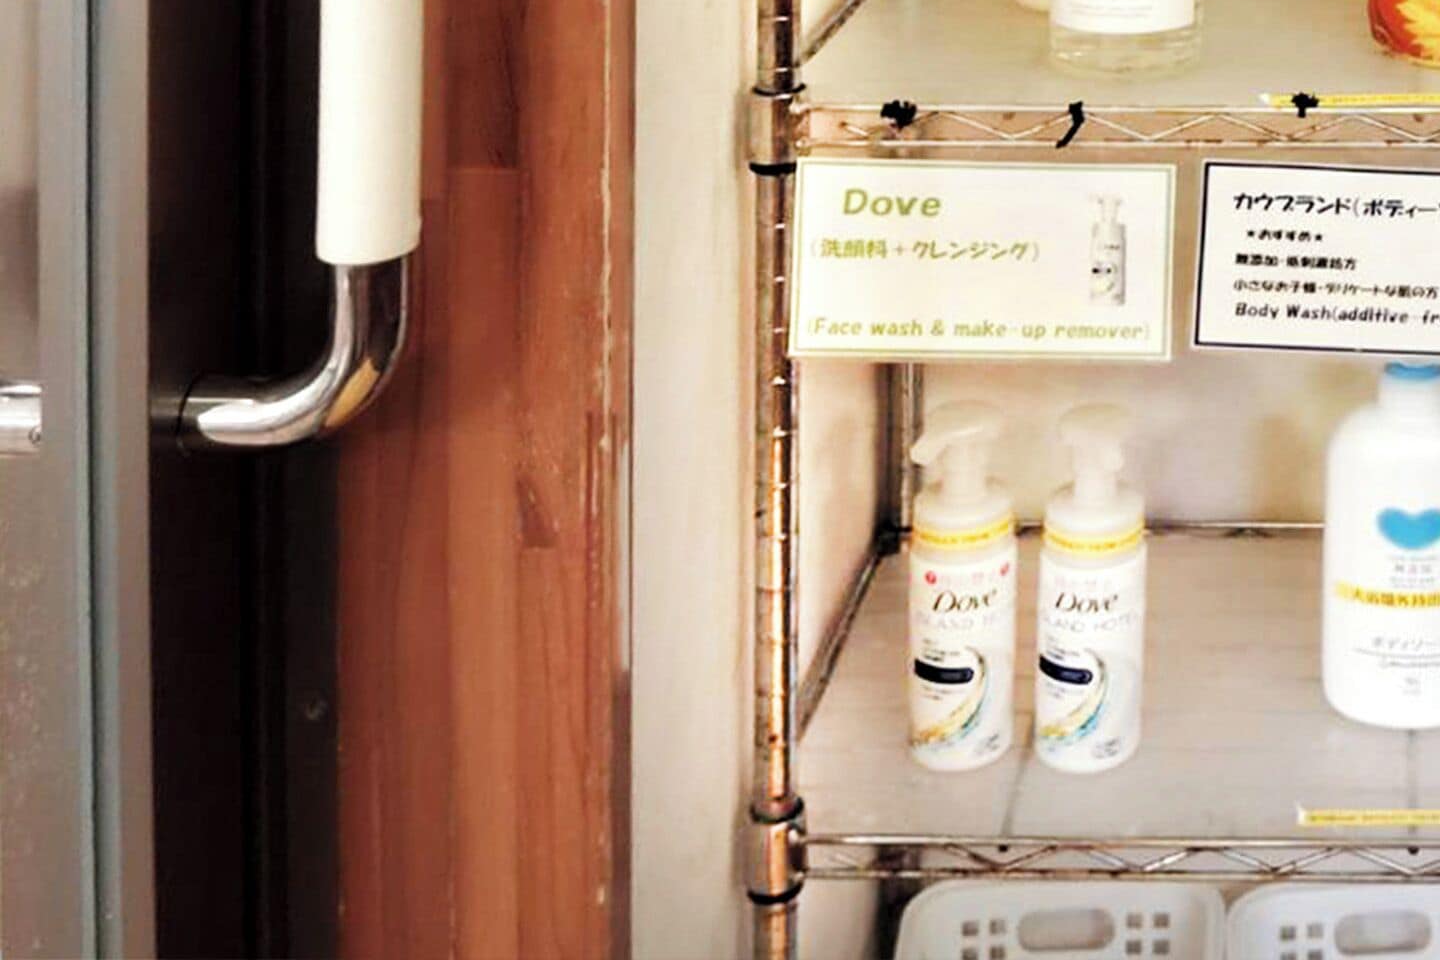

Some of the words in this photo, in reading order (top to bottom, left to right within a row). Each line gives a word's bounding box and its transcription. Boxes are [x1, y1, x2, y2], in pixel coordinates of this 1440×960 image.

[842, 187, 942, 218] Dove
[1235, 302, 1280, 320] Body
[869, 319, 923, 337] wash
[930, 320, 945, 337] &
[932, 588, 998, 614] Dove
[1054, 590, 1119, 614] Dove
